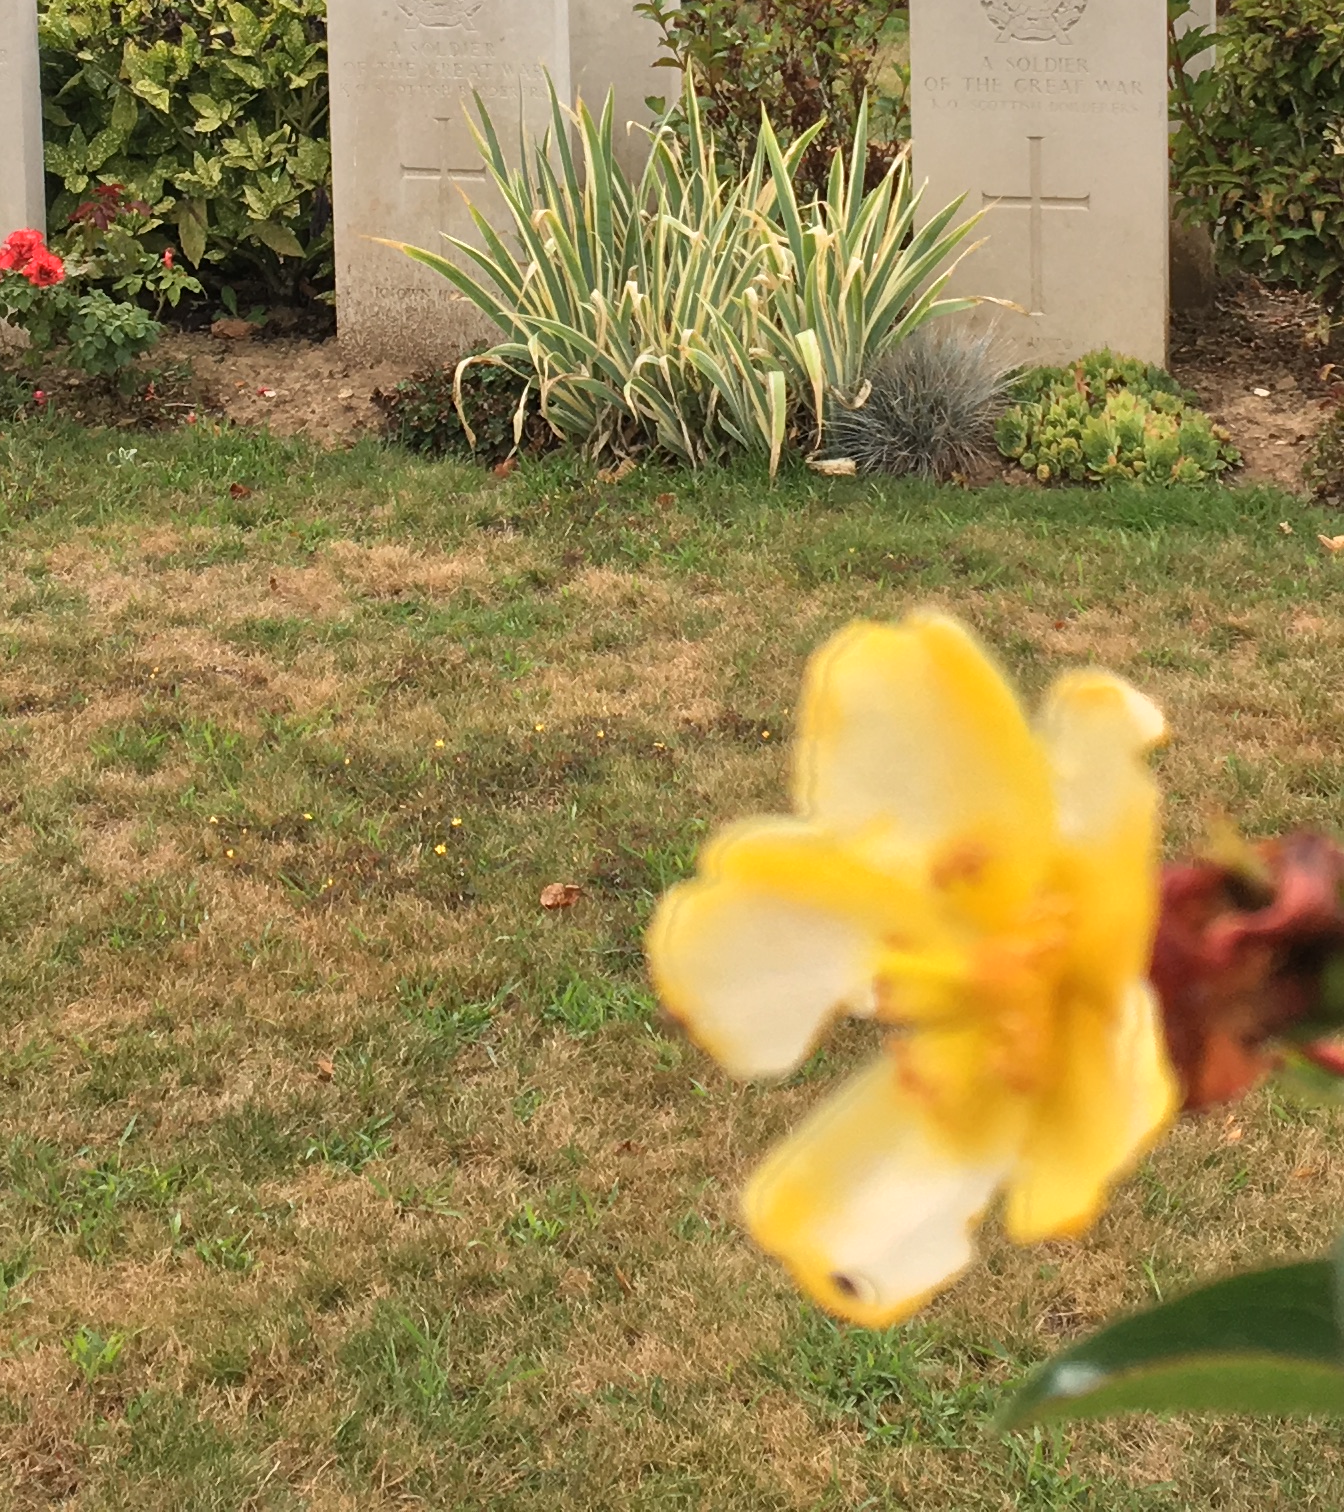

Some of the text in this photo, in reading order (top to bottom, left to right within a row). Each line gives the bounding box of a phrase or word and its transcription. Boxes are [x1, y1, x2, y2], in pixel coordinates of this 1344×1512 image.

[389, 41, 497, 59] A SOLDIER
[343, 62, 367, 79] OF
[376, 62, 418, 80] THE
[424, 62, 493, 80] GREAT
[983, 56, 1091, 74] A SOLDIER
[924, 76, 1145, 96] OF THE GREAT WAR
